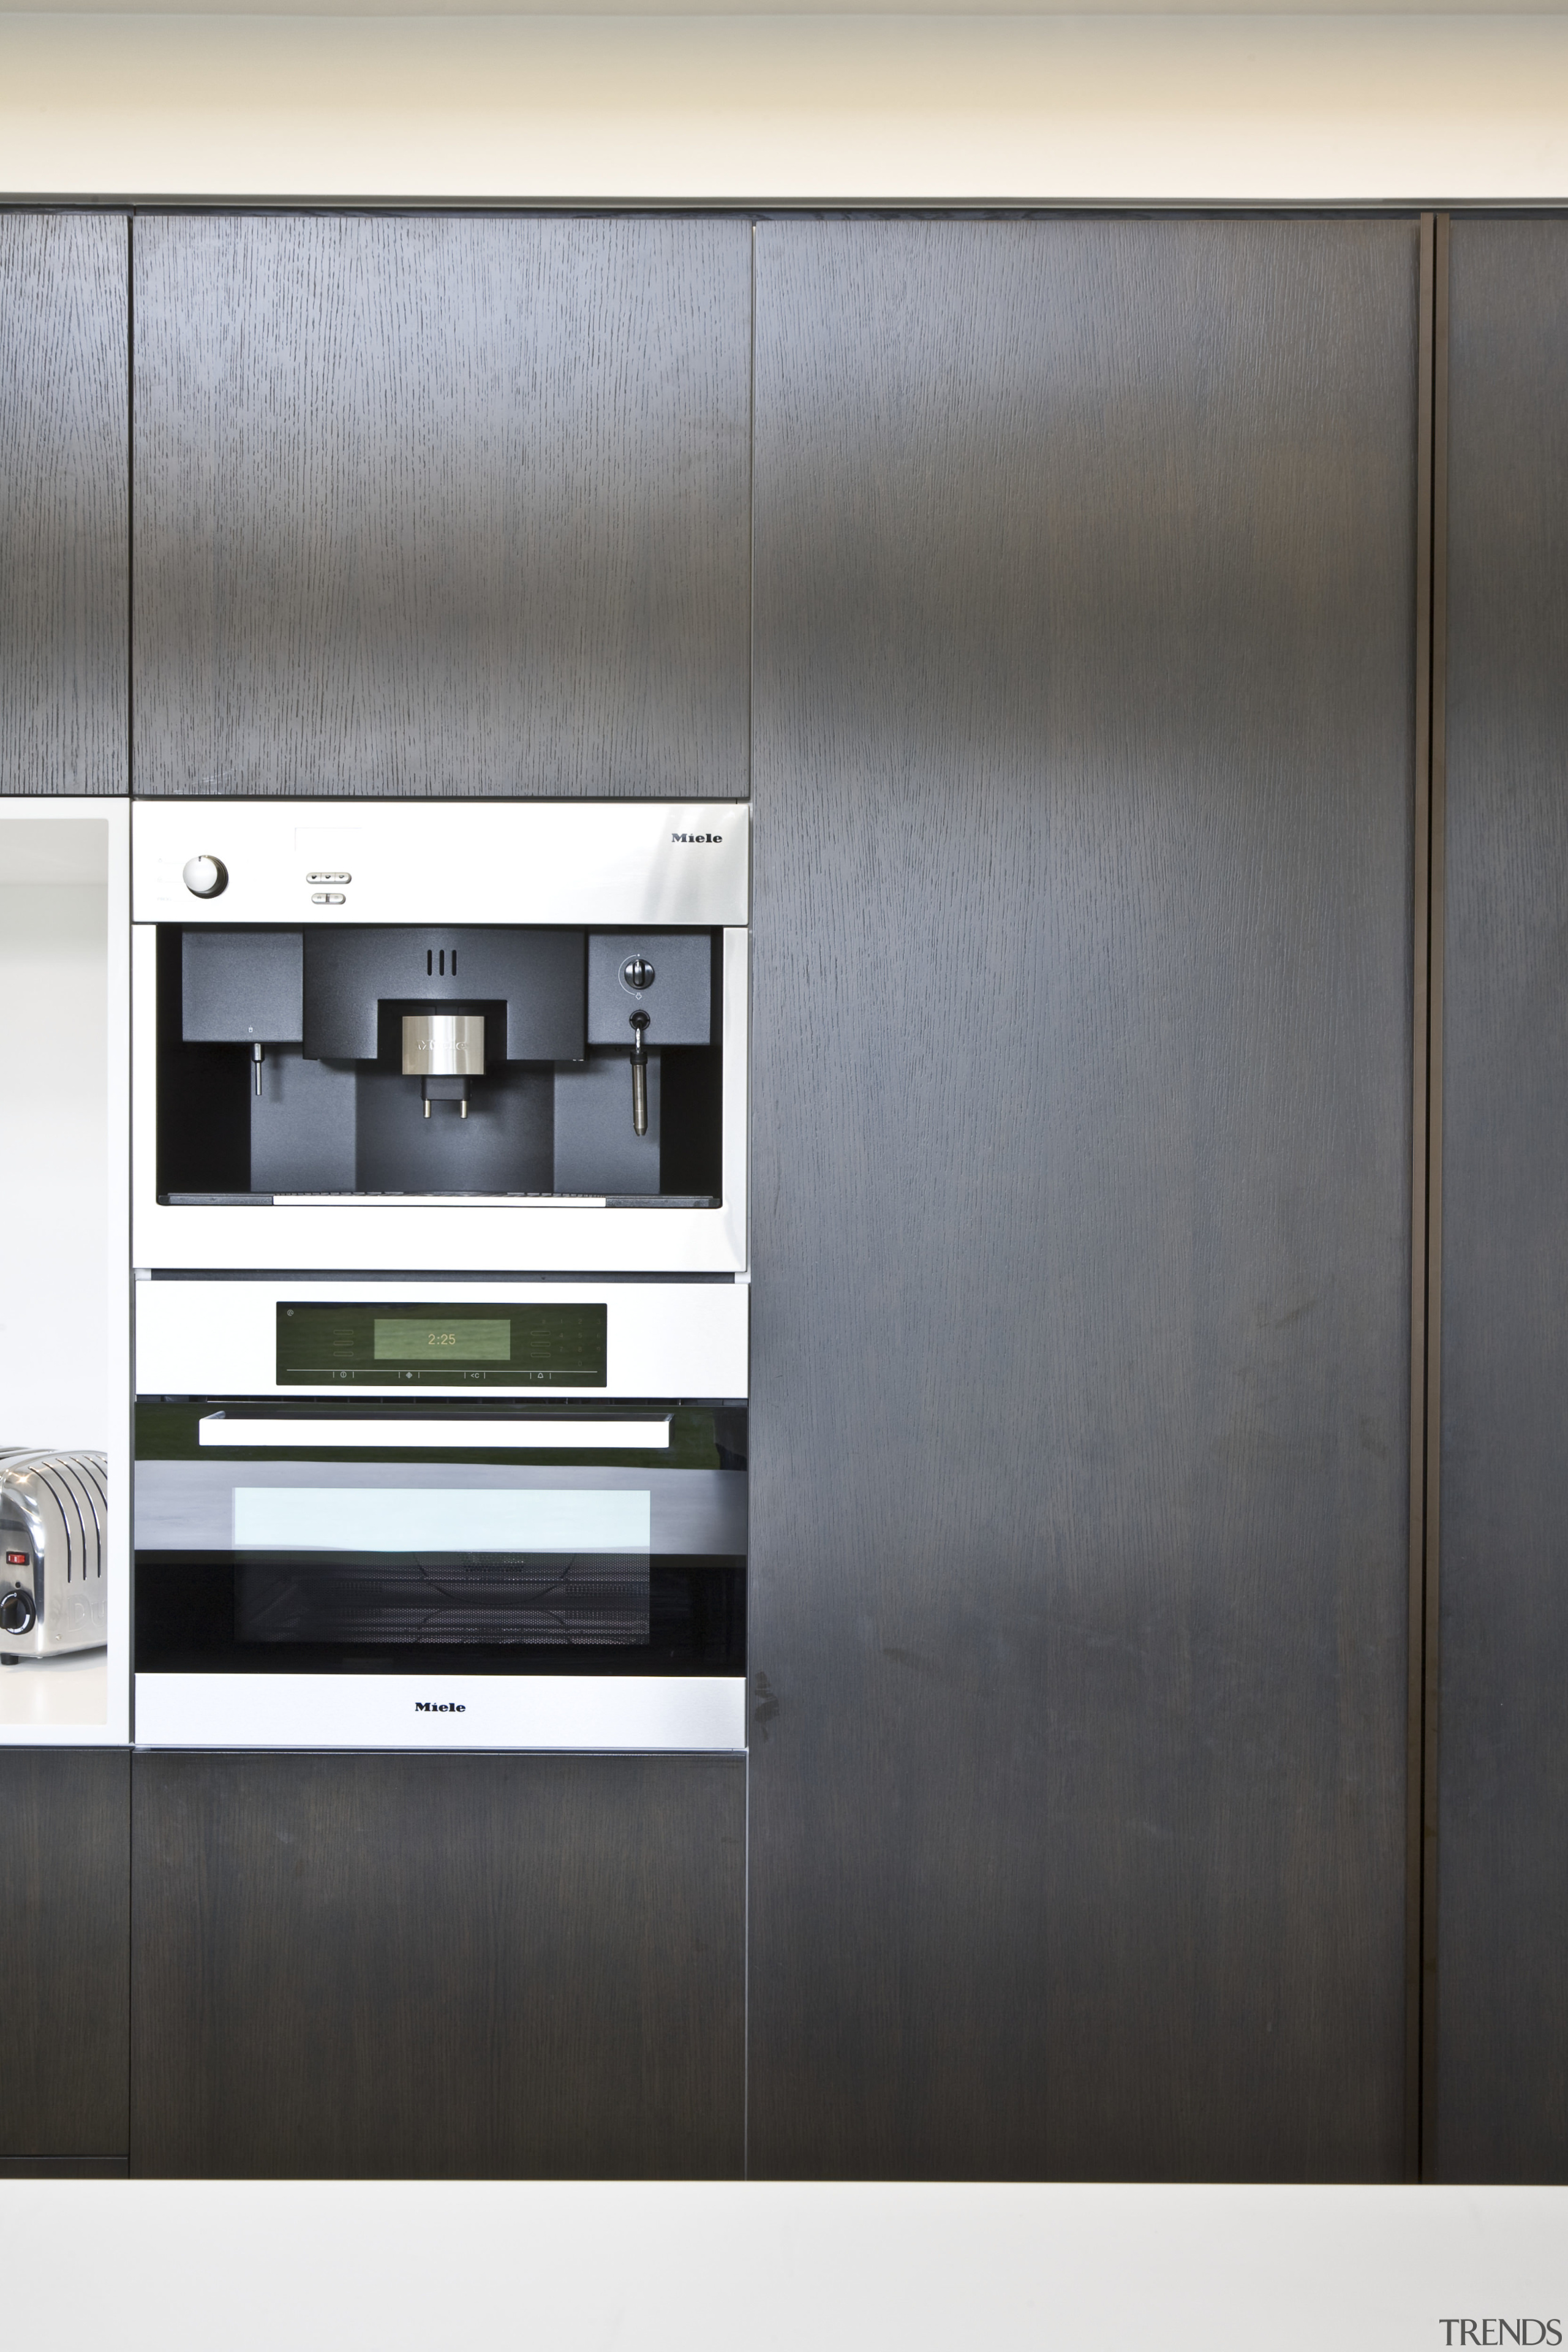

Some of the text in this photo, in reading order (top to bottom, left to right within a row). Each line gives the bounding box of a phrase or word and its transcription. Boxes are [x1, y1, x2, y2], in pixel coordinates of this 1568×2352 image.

[671, 833, 723, 843] Miele
[428, 1333, 456, 1345] 2:25
[415, 1702, 466, 1713] Miele
